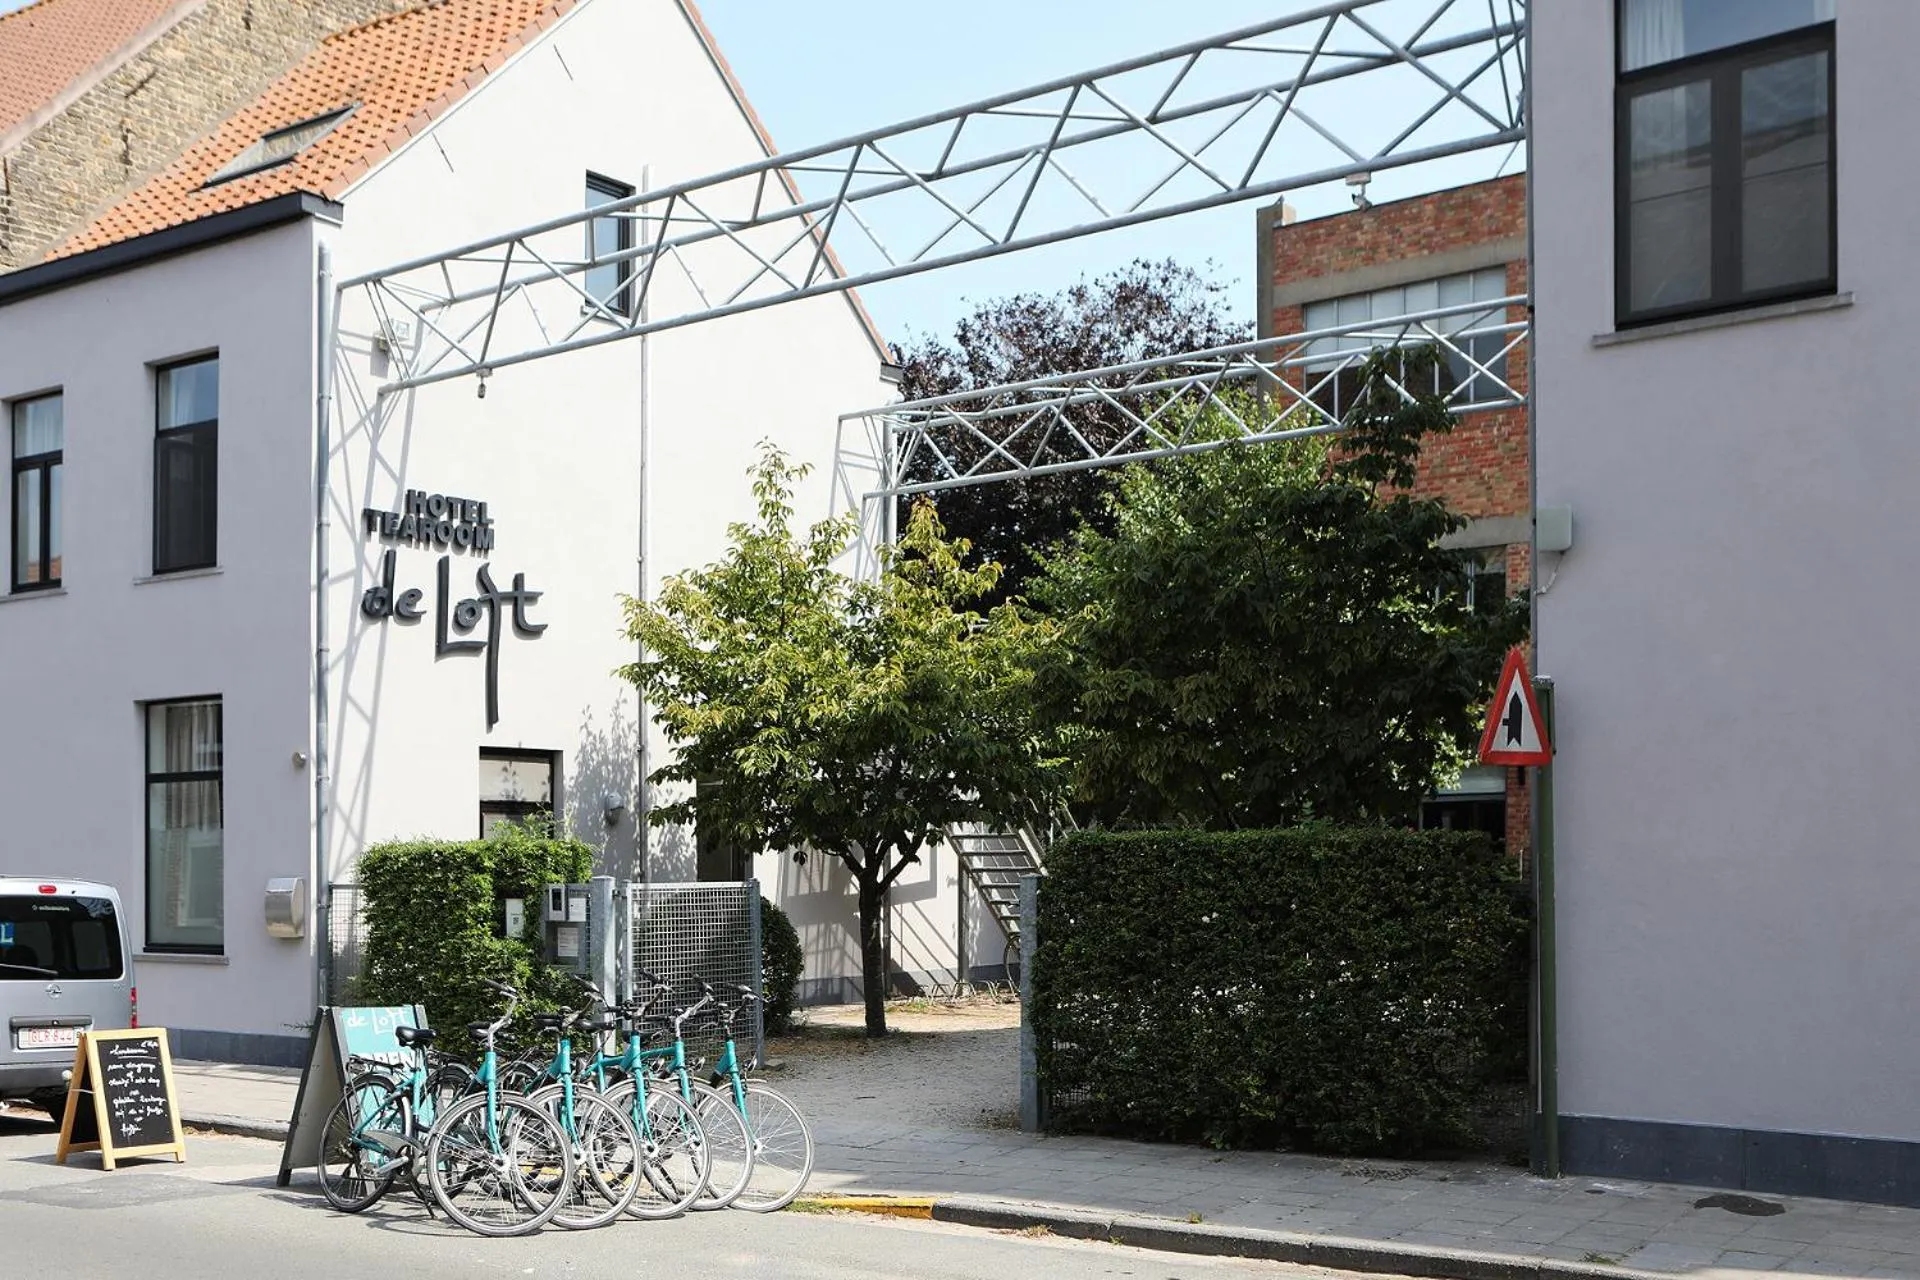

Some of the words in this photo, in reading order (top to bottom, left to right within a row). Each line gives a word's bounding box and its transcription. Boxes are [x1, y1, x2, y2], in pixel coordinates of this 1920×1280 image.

[406, 489, 494, 524] HOTEL
[363, 508, 494, 552] TEAROOM
[362, 549, 427, 621] de
[434, 555, 548, 733] Loft
